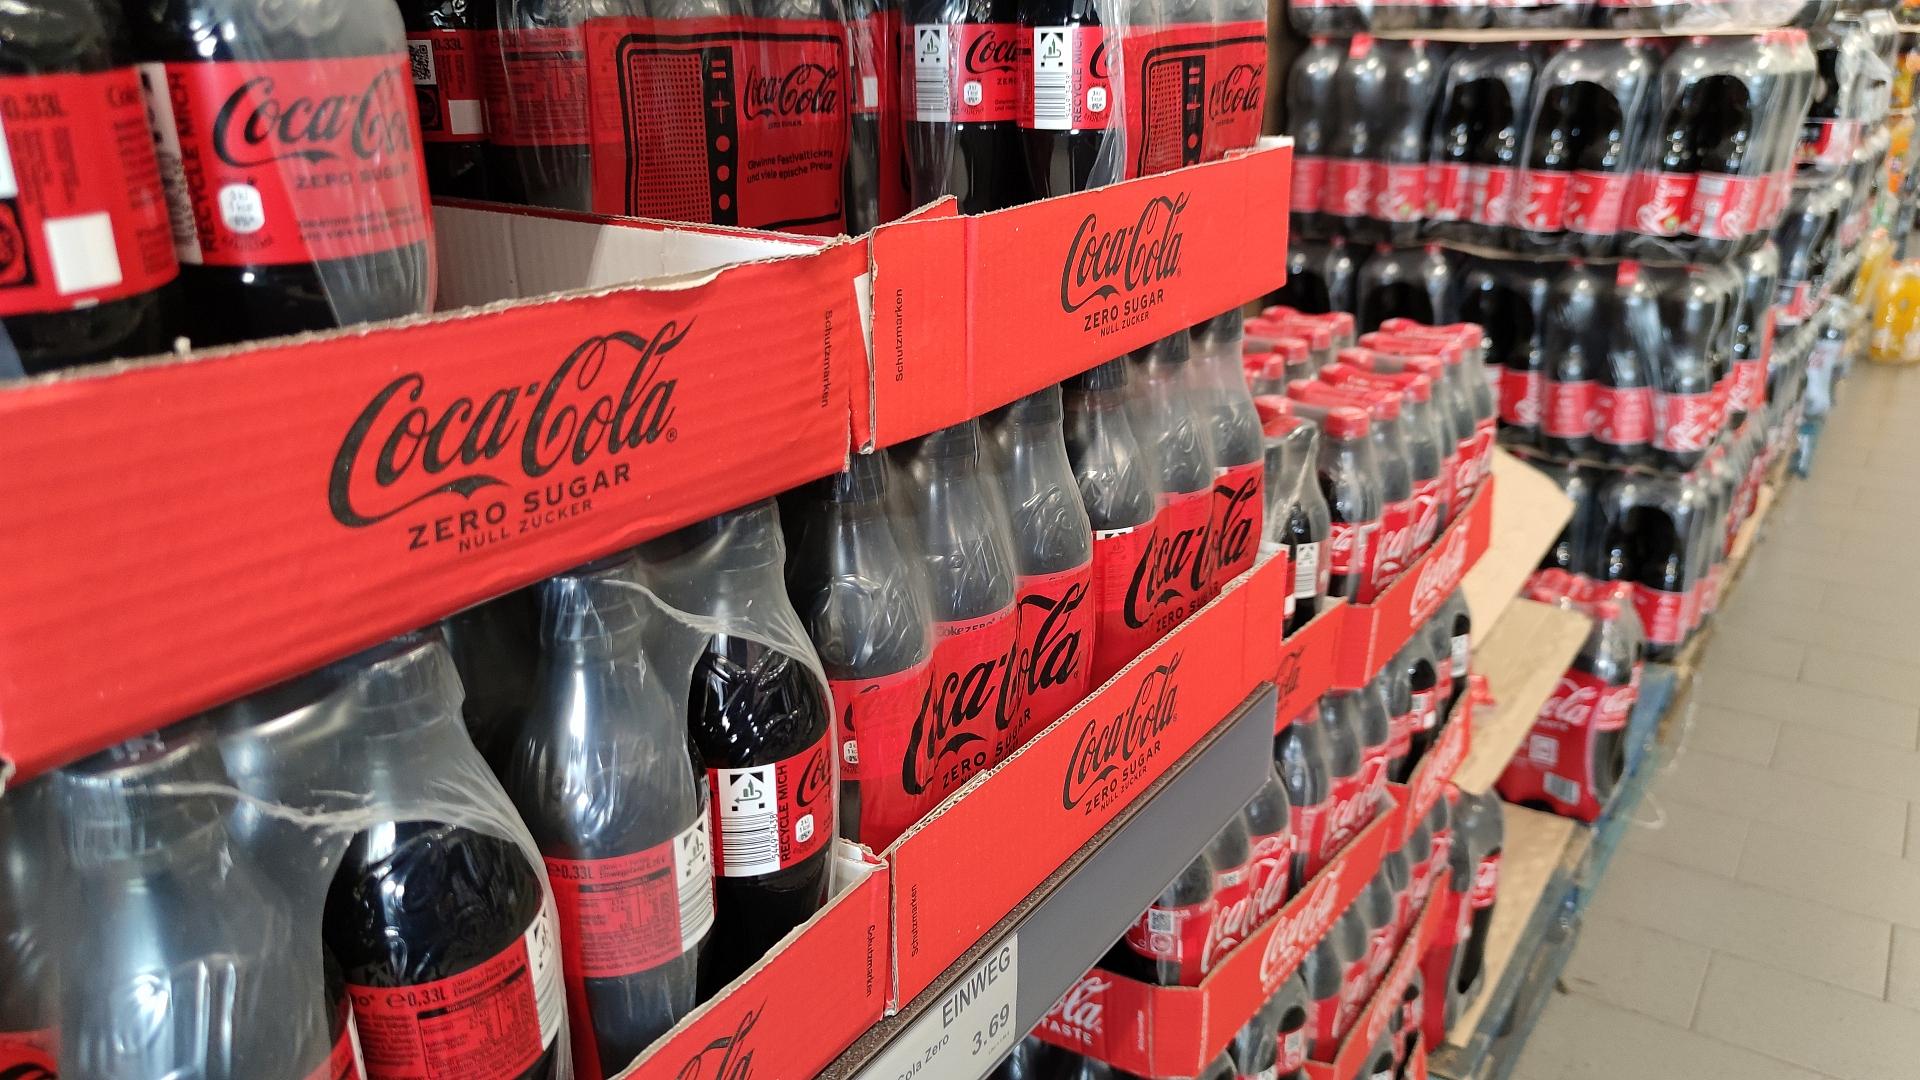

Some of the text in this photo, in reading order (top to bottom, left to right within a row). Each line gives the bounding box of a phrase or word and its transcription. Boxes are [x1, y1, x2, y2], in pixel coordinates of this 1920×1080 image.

[1072, 31, 1083, 123] RECYCLE MICH
[746, 173, 761, 184] und
[1060, 191, 1191, 313] Coca-Cola
[895, 288, 904, 382] Schutzmarken
[1083, 288, 1164, 332] ZERO SUGAR
[1100, 311, 1150, 337] NULL ZUCKER
[821, 309, 833, 408] Schutzmarken
[328, 314, 698, 529] Coca-Cola
[407, 462, 632, 550] ZERO SUGAR
[458, 499, 593, 552] NULL ZUCKER
[1155, 606, 1184, 633] ZERO
[942, 707, 1032, 790] ZERO SUGAR
[1062, 649, 1185, 811] Coca-Cola
[776, 764, 791, 863] RECYCLE MICH
[1085, 740, 1161, 816] ZERO SUGAR
[1100, 766, 1147, 812] NULL ZUCKER
[769, 813, 780, 859] 5449 3438
[911, 884, 919, 958] Schutzmarken
[866, 924, 876, 998] Schutzmarken
[942, 946, 1011, 1029] EINWEG
[924, 1034, 950, 1064] Zero
[972, 1003, 1010, 1056] 3.69
[1041, 1017, 1094, 1047] TASTE
